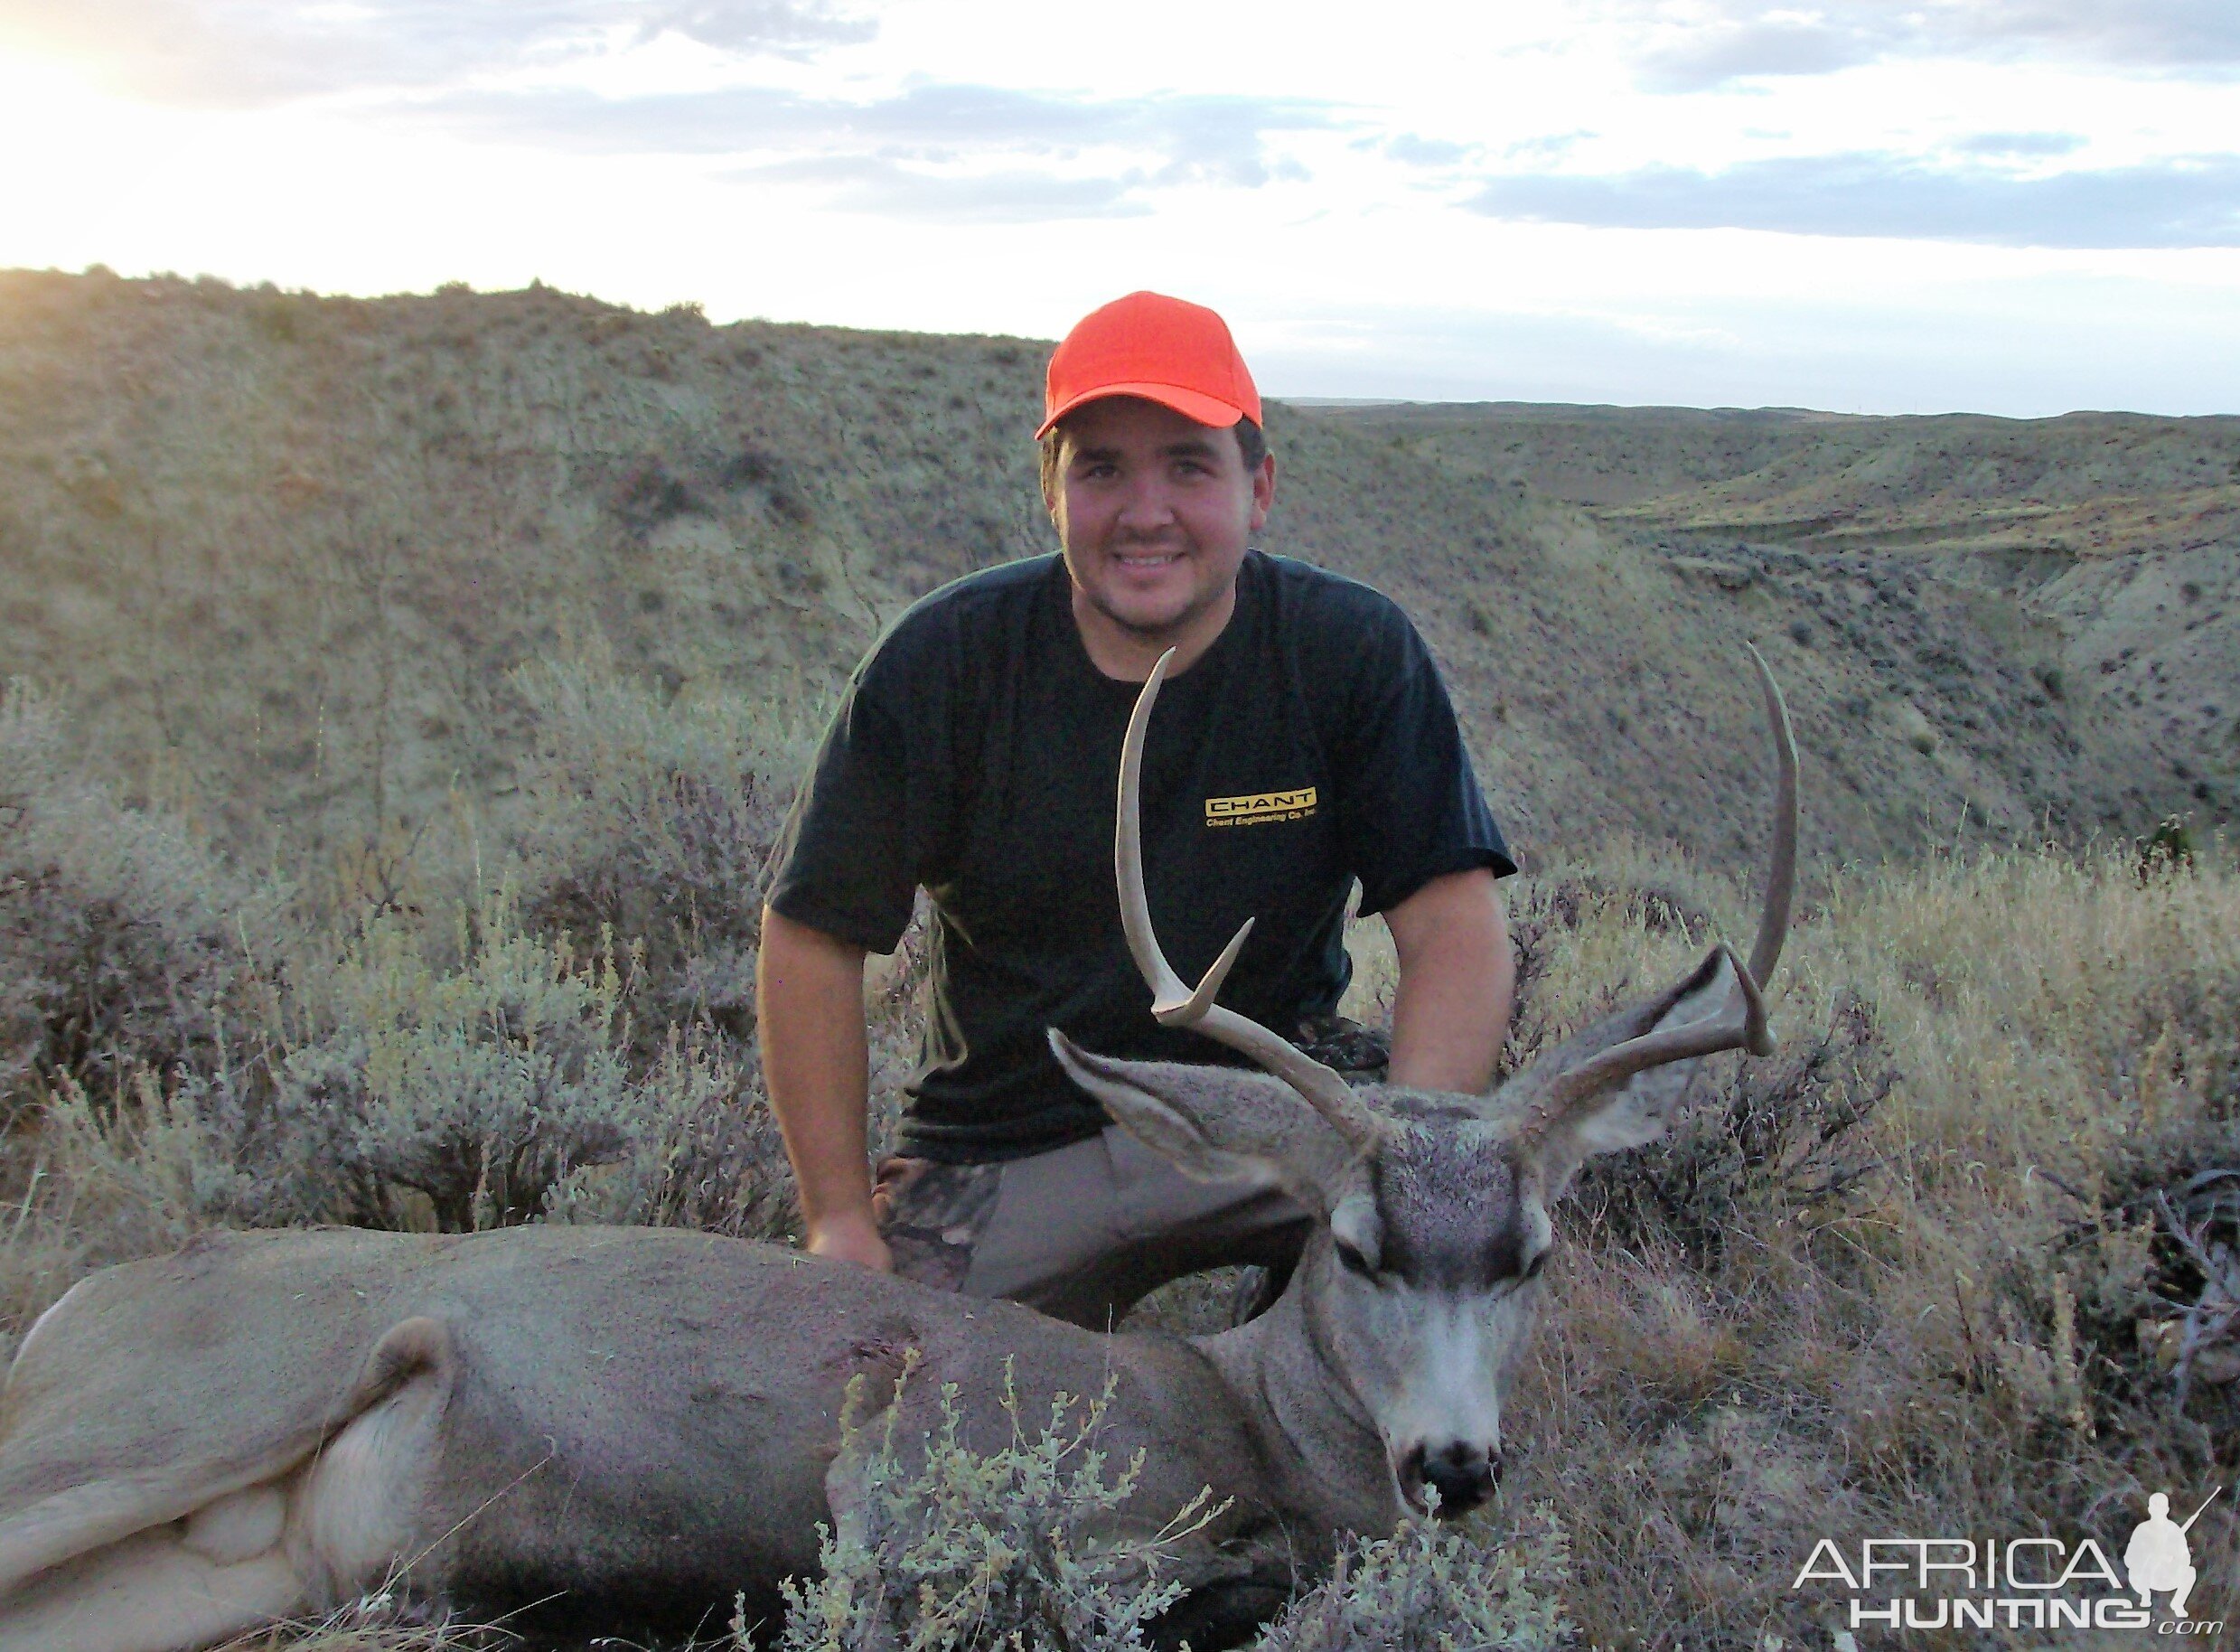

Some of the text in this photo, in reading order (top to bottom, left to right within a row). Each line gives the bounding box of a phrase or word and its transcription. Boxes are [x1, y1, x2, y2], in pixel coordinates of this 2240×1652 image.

[1210, 792, 1312, 812] CHANT
[1206, 818, 1233, 828] Chant
[1235, 813, 1287, 826] Engineering
